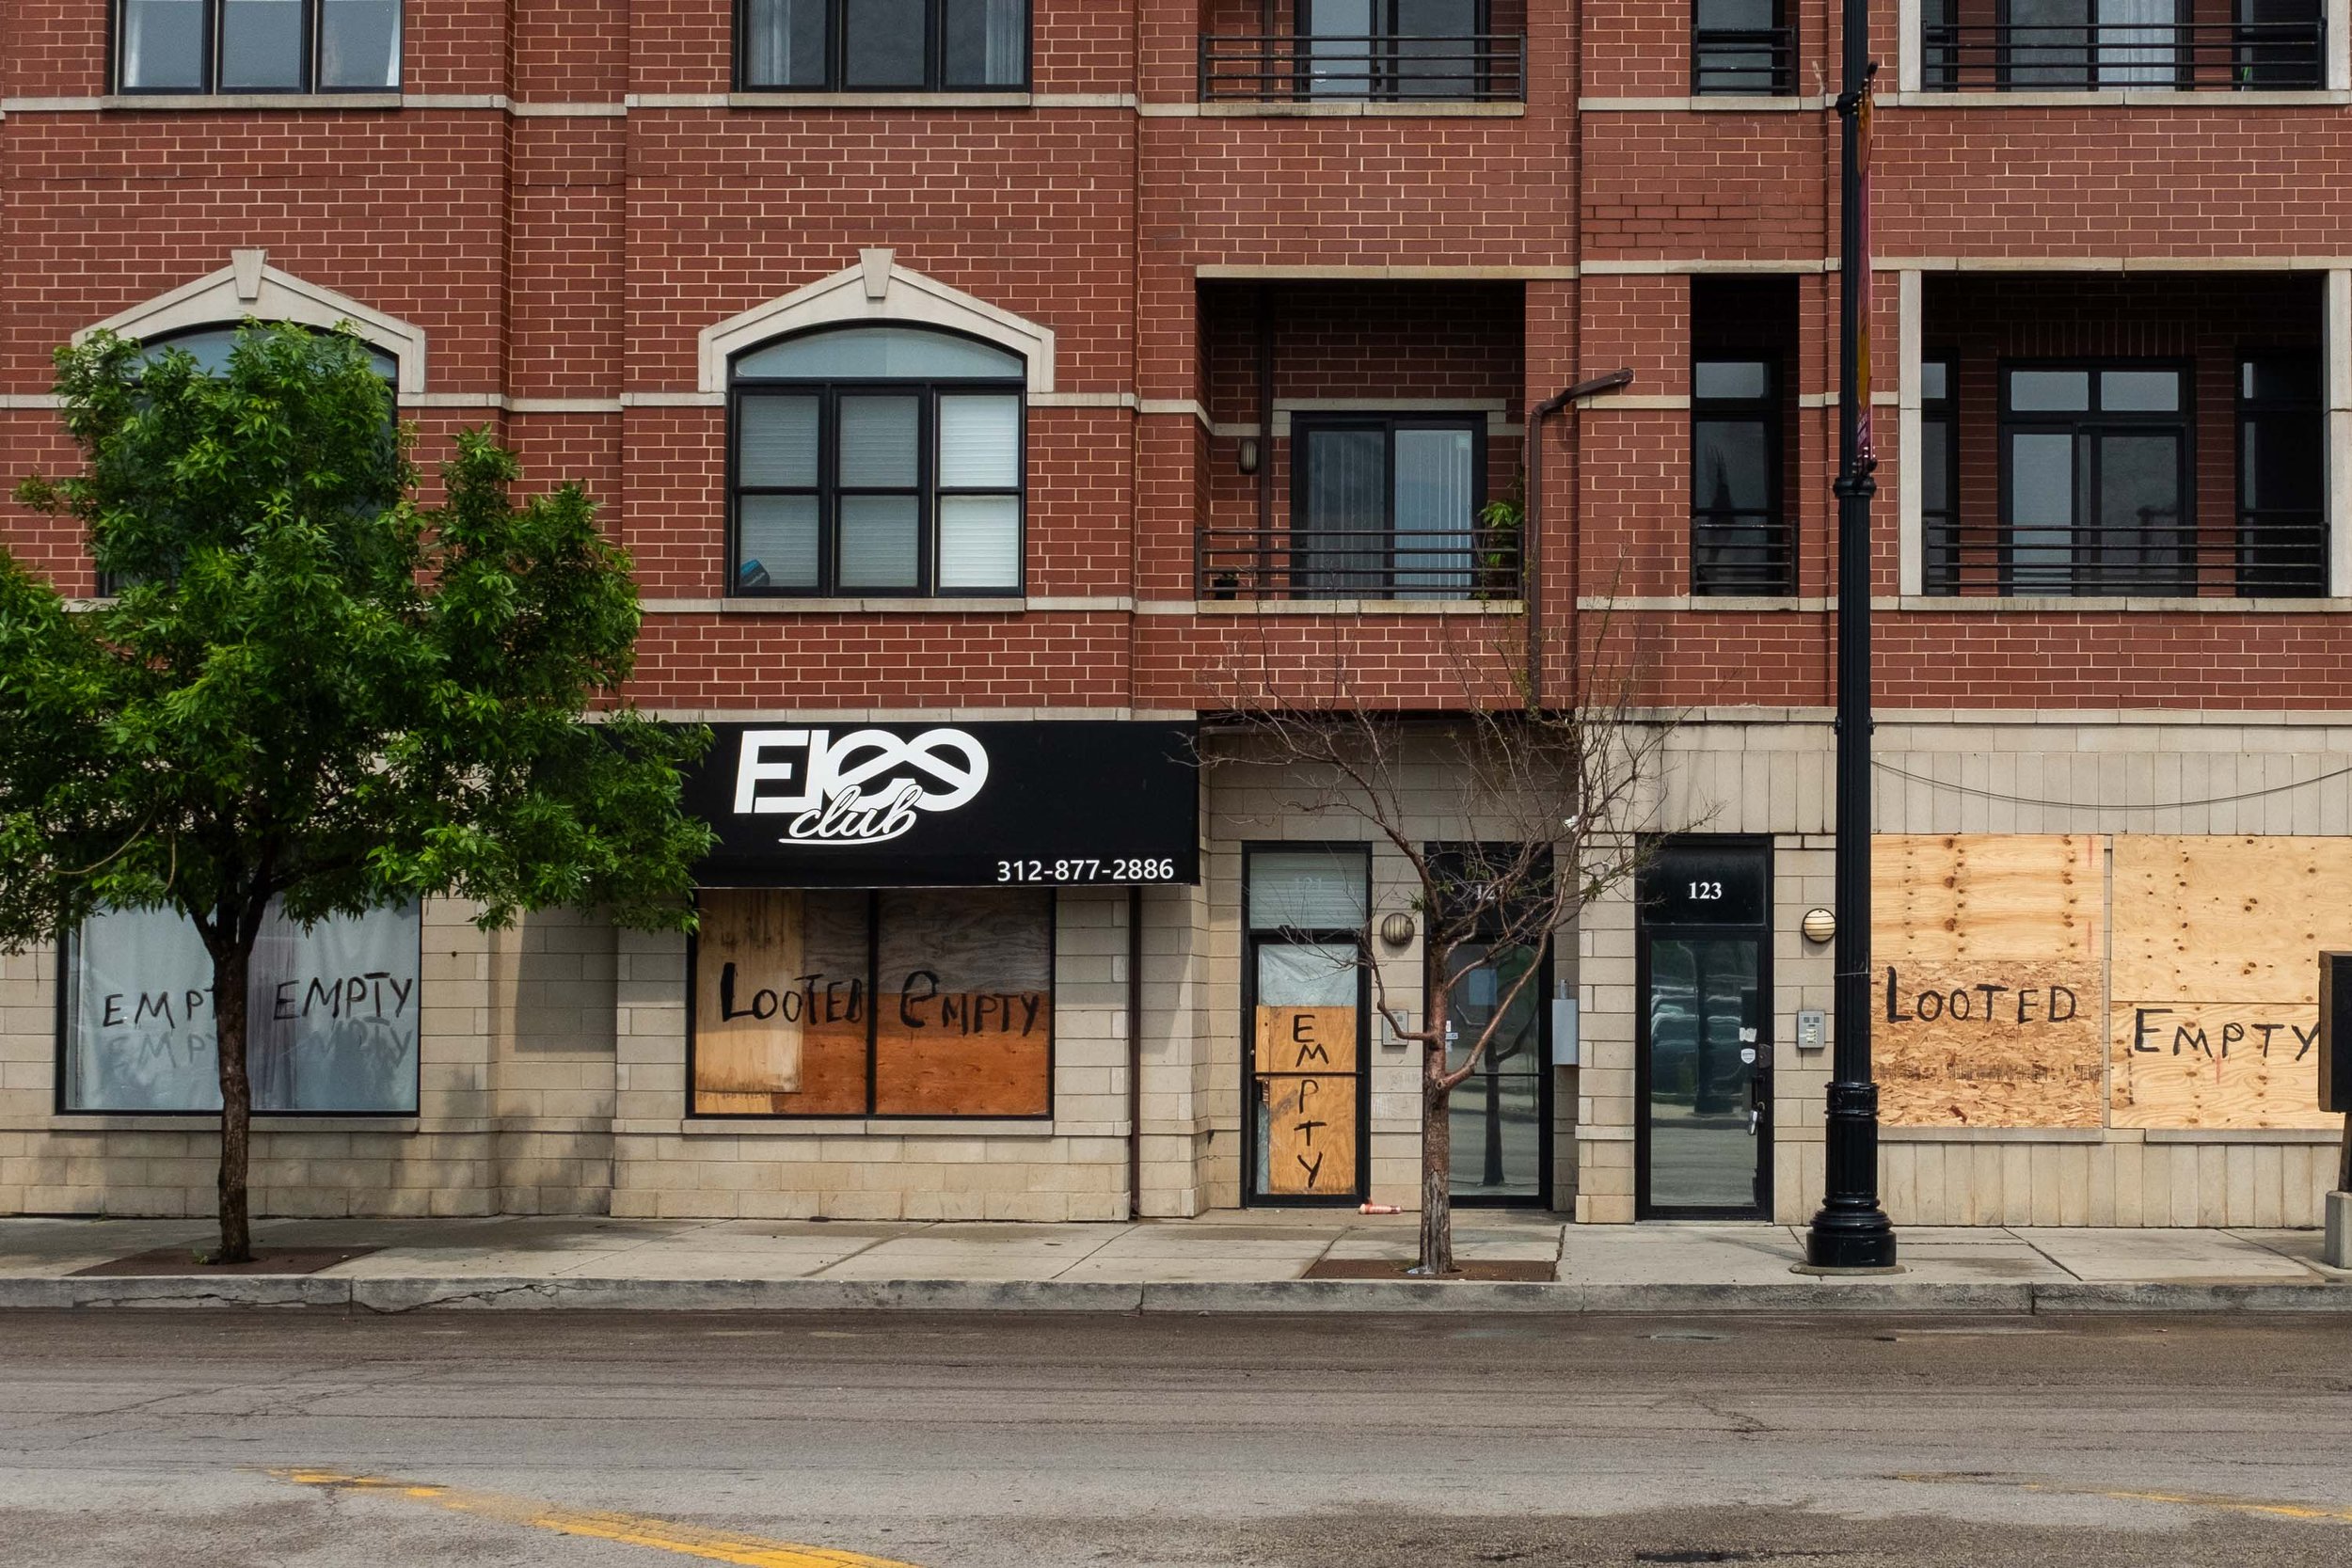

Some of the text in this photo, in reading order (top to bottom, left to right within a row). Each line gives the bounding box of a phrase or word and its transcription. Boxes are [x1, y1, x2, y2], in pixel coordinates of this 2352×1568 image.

[997, 859, 1174, 881] 312-877-2886
[1689, 881, 1722, 899] 123
[273, 972, 413, 1022] EMPTY
[720, 962, 863, 1026] LOOTED
[1886, 965, 2319, 1061] LOOTED EMPTY
[1293, 1014, 1329, 1188] EMPTY
